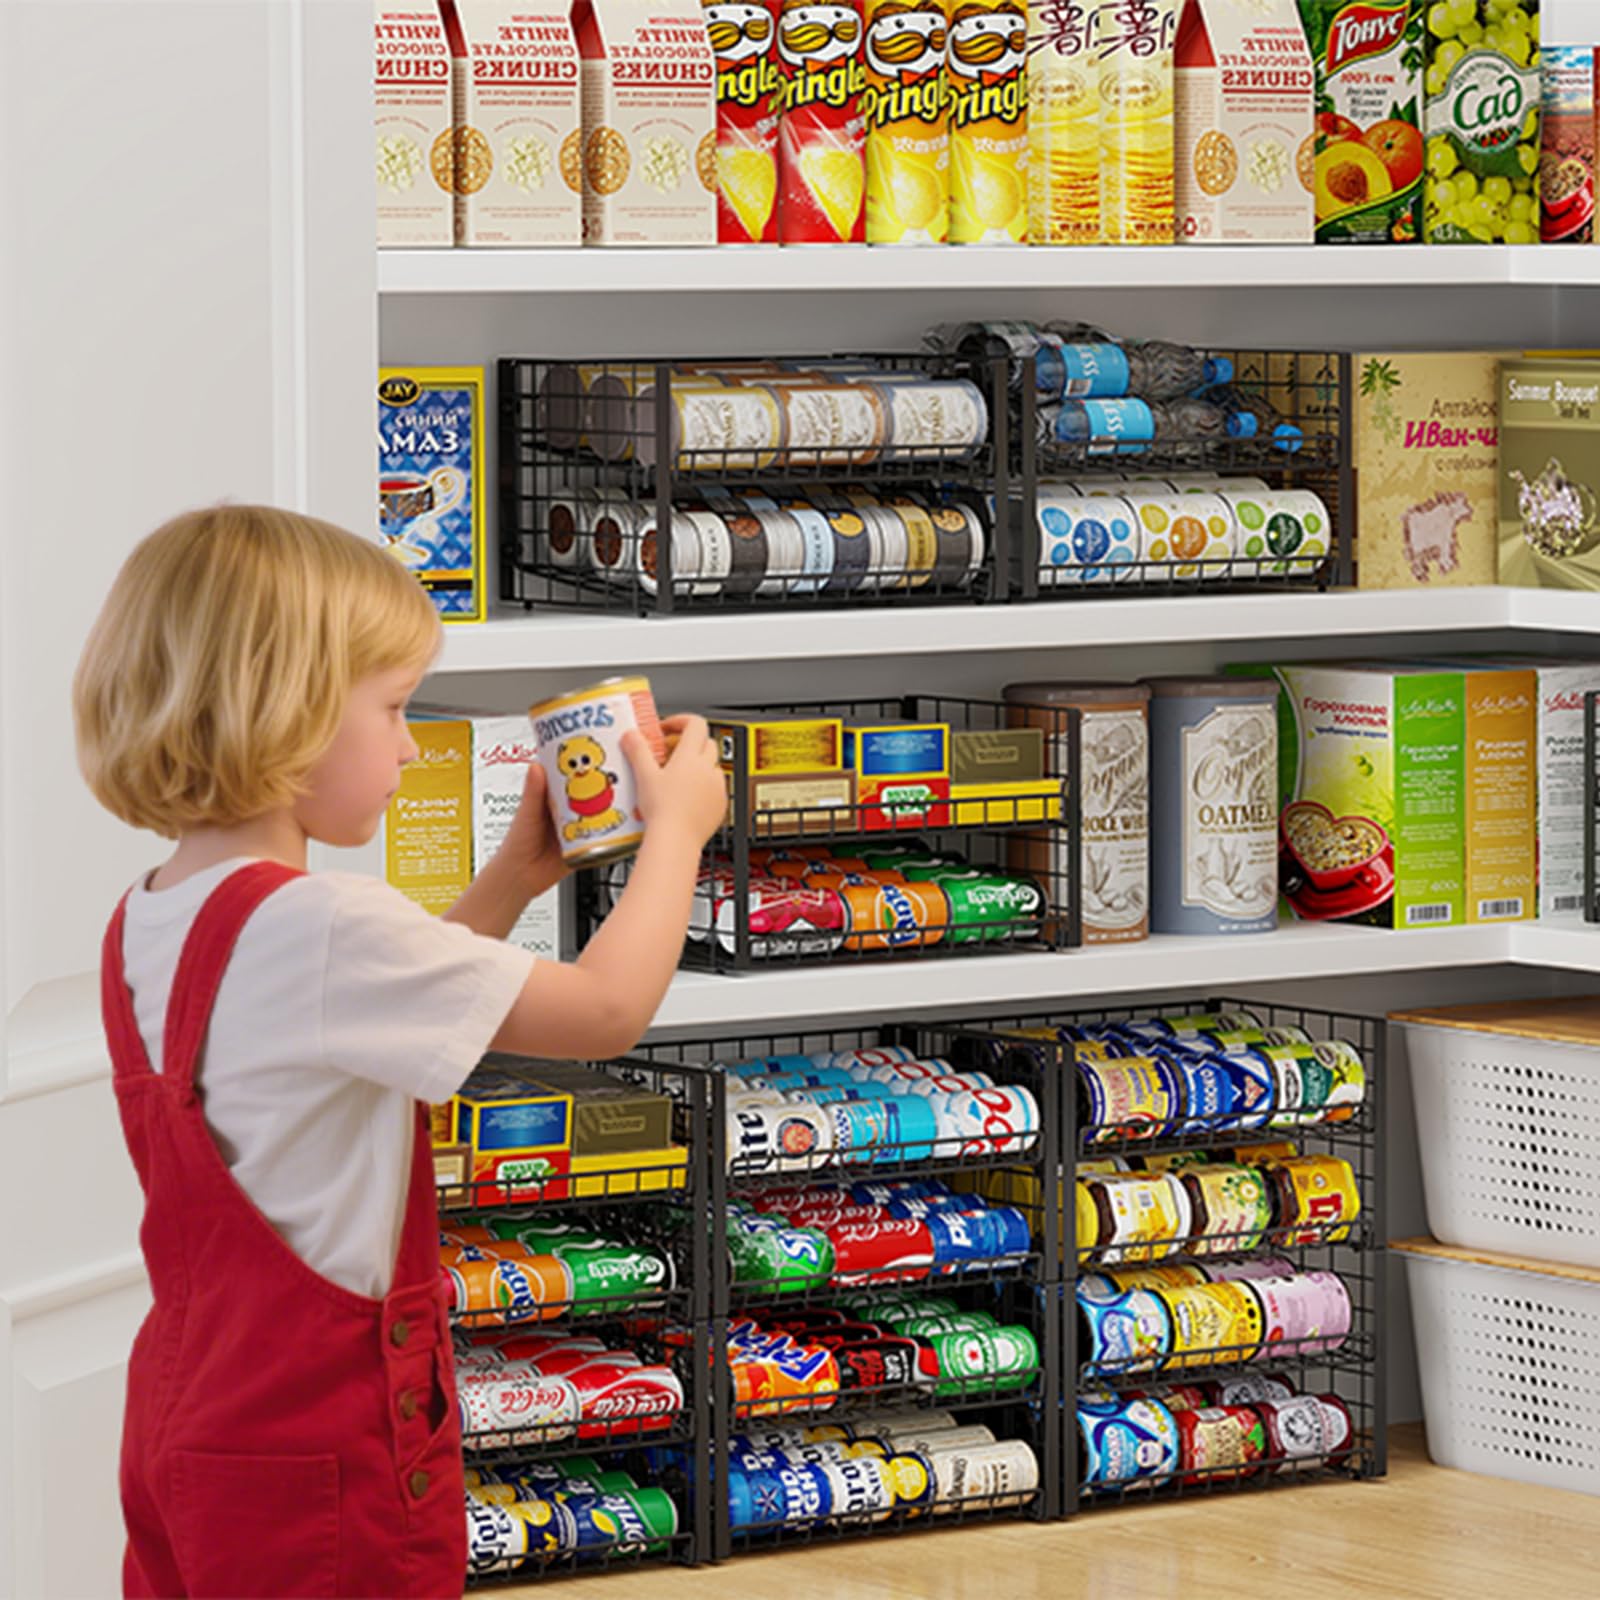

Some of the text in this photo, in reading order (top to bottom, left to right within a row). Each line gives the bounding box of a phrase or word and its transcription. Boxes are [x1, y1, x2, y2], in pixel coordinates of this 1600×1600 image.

[717, 57, 777, 105] ngle
[778, 57, 865, 109] ringle
[865, 70, 948, 126] Pringl
[949, 70, 1028, 126] ringl
[382, 384, 414, 397] JAY
[378, 431, 459, 453] МАЗ
[483, 793, 522, 805] Рисо
[1198, 804, 1273, 826] OATME
